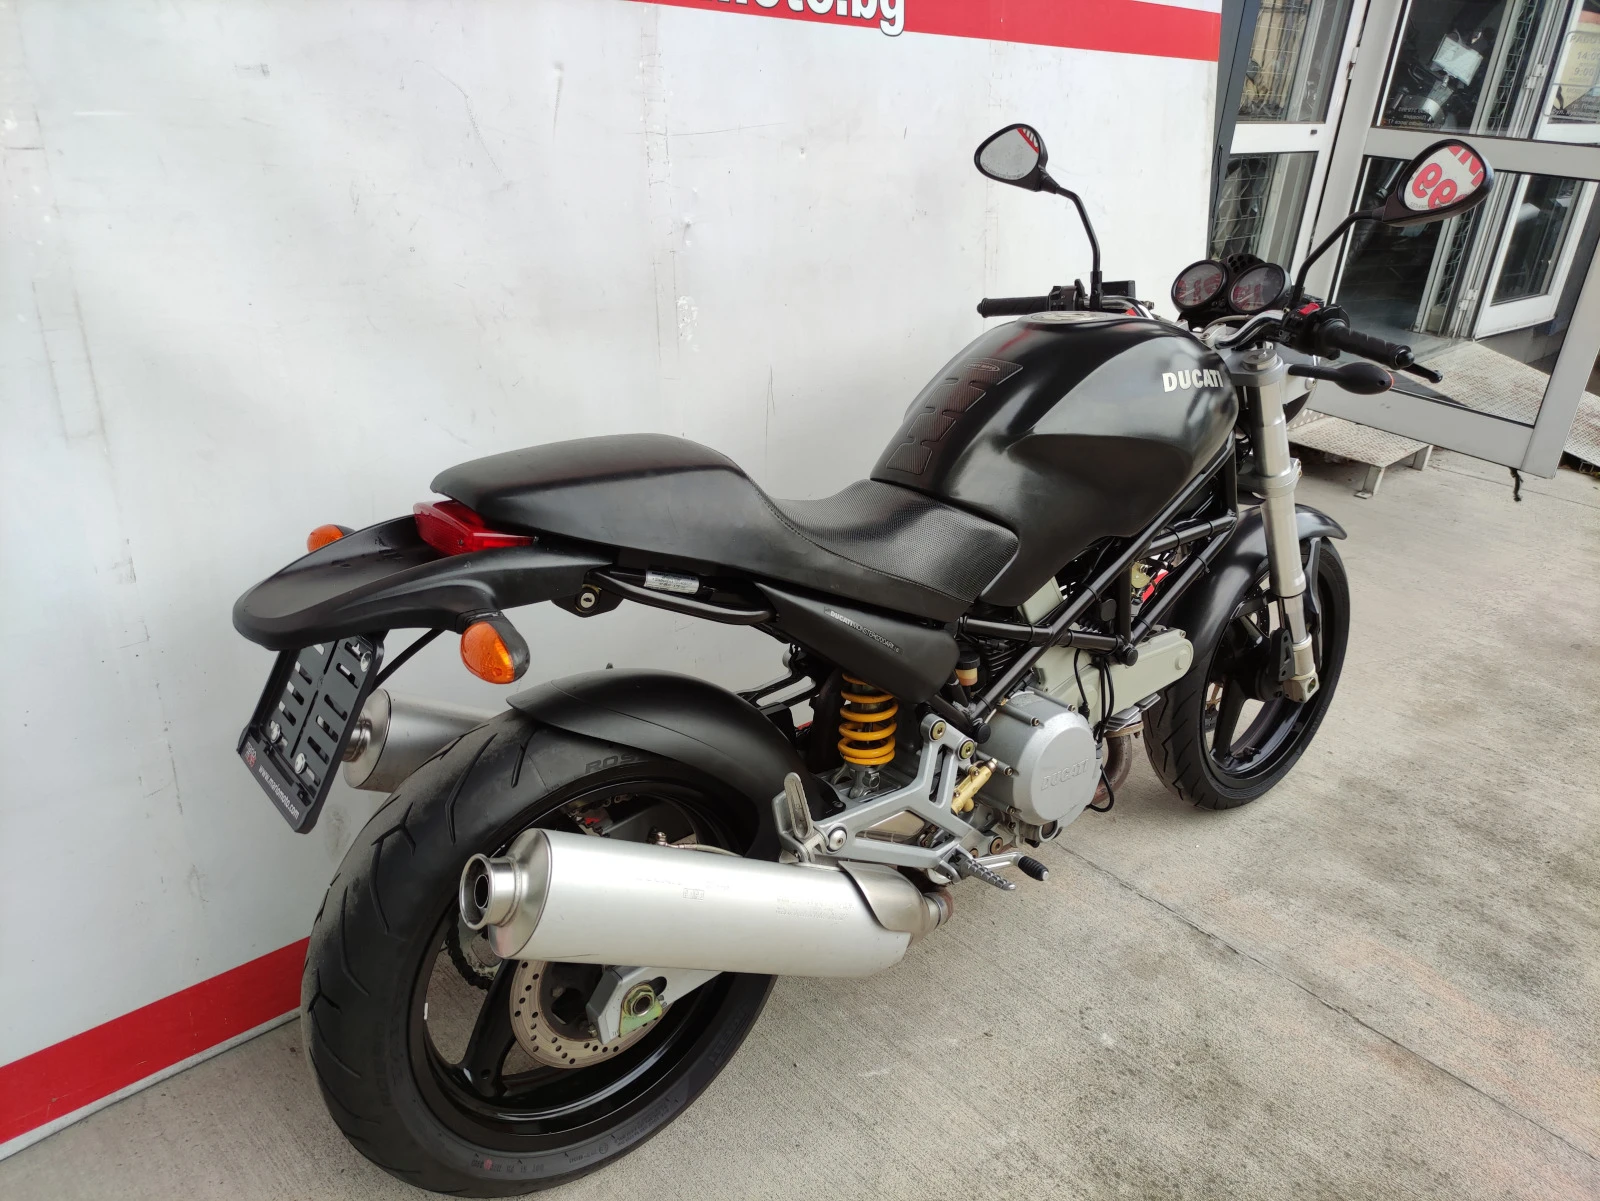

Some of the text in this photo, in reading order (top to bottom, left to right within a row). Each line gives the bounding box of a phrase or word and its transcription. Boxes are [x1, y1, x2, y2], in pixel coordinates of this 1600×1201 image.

[1162, 369, 1224, 393] DUCATI
[1041, 759, 1088, 791] DUCATI
[258, 764, 301, 820] www.mariomoto.com
